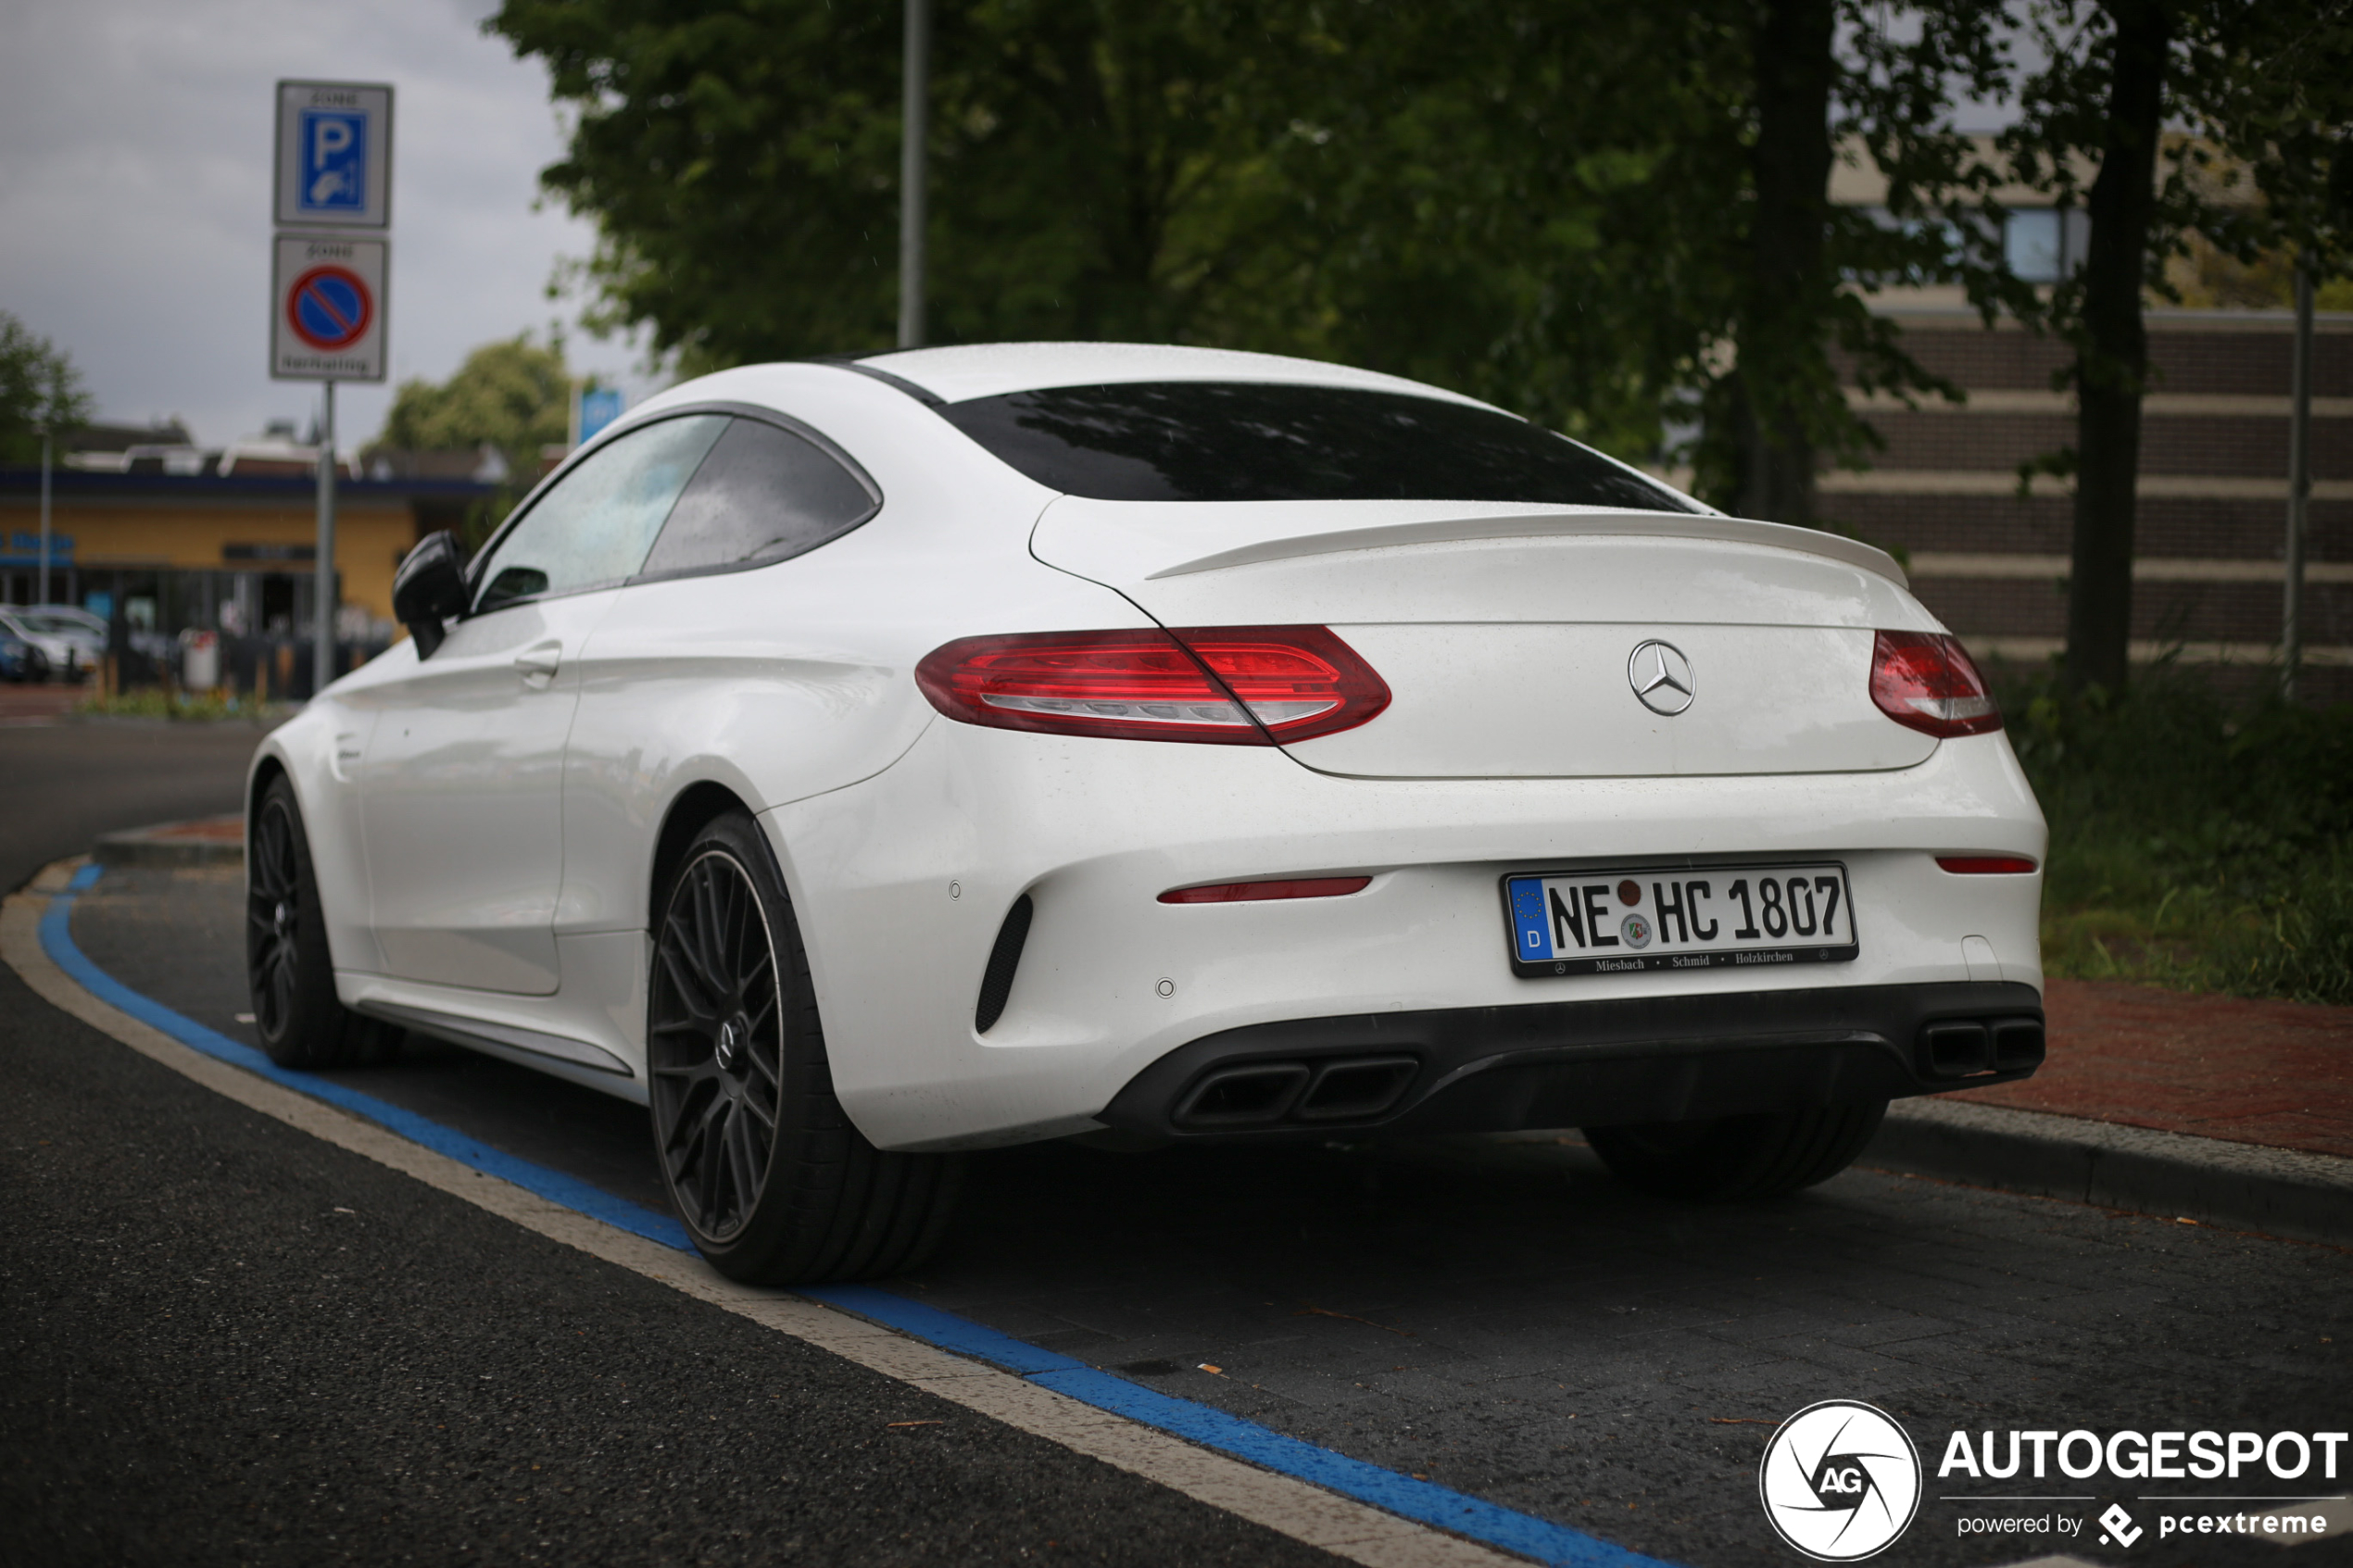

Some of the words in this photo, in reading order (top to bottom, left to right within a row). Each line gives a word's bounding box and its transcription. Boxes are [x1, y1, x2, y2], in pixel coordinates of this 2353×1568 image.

[315, 119, 354, 170] P
[1548, 884, 1620, 949] NE
[1653, 880, 1719, 943] HC
[1728, 876, 1841, 939] 1807
[1528, 930, 1541, 948] D
[1595, 957, 1644, 972] Miesbach
[1672, 955, 1710, 968] Schmid
[1735, 950, 1793, 965] Holzkirchen
